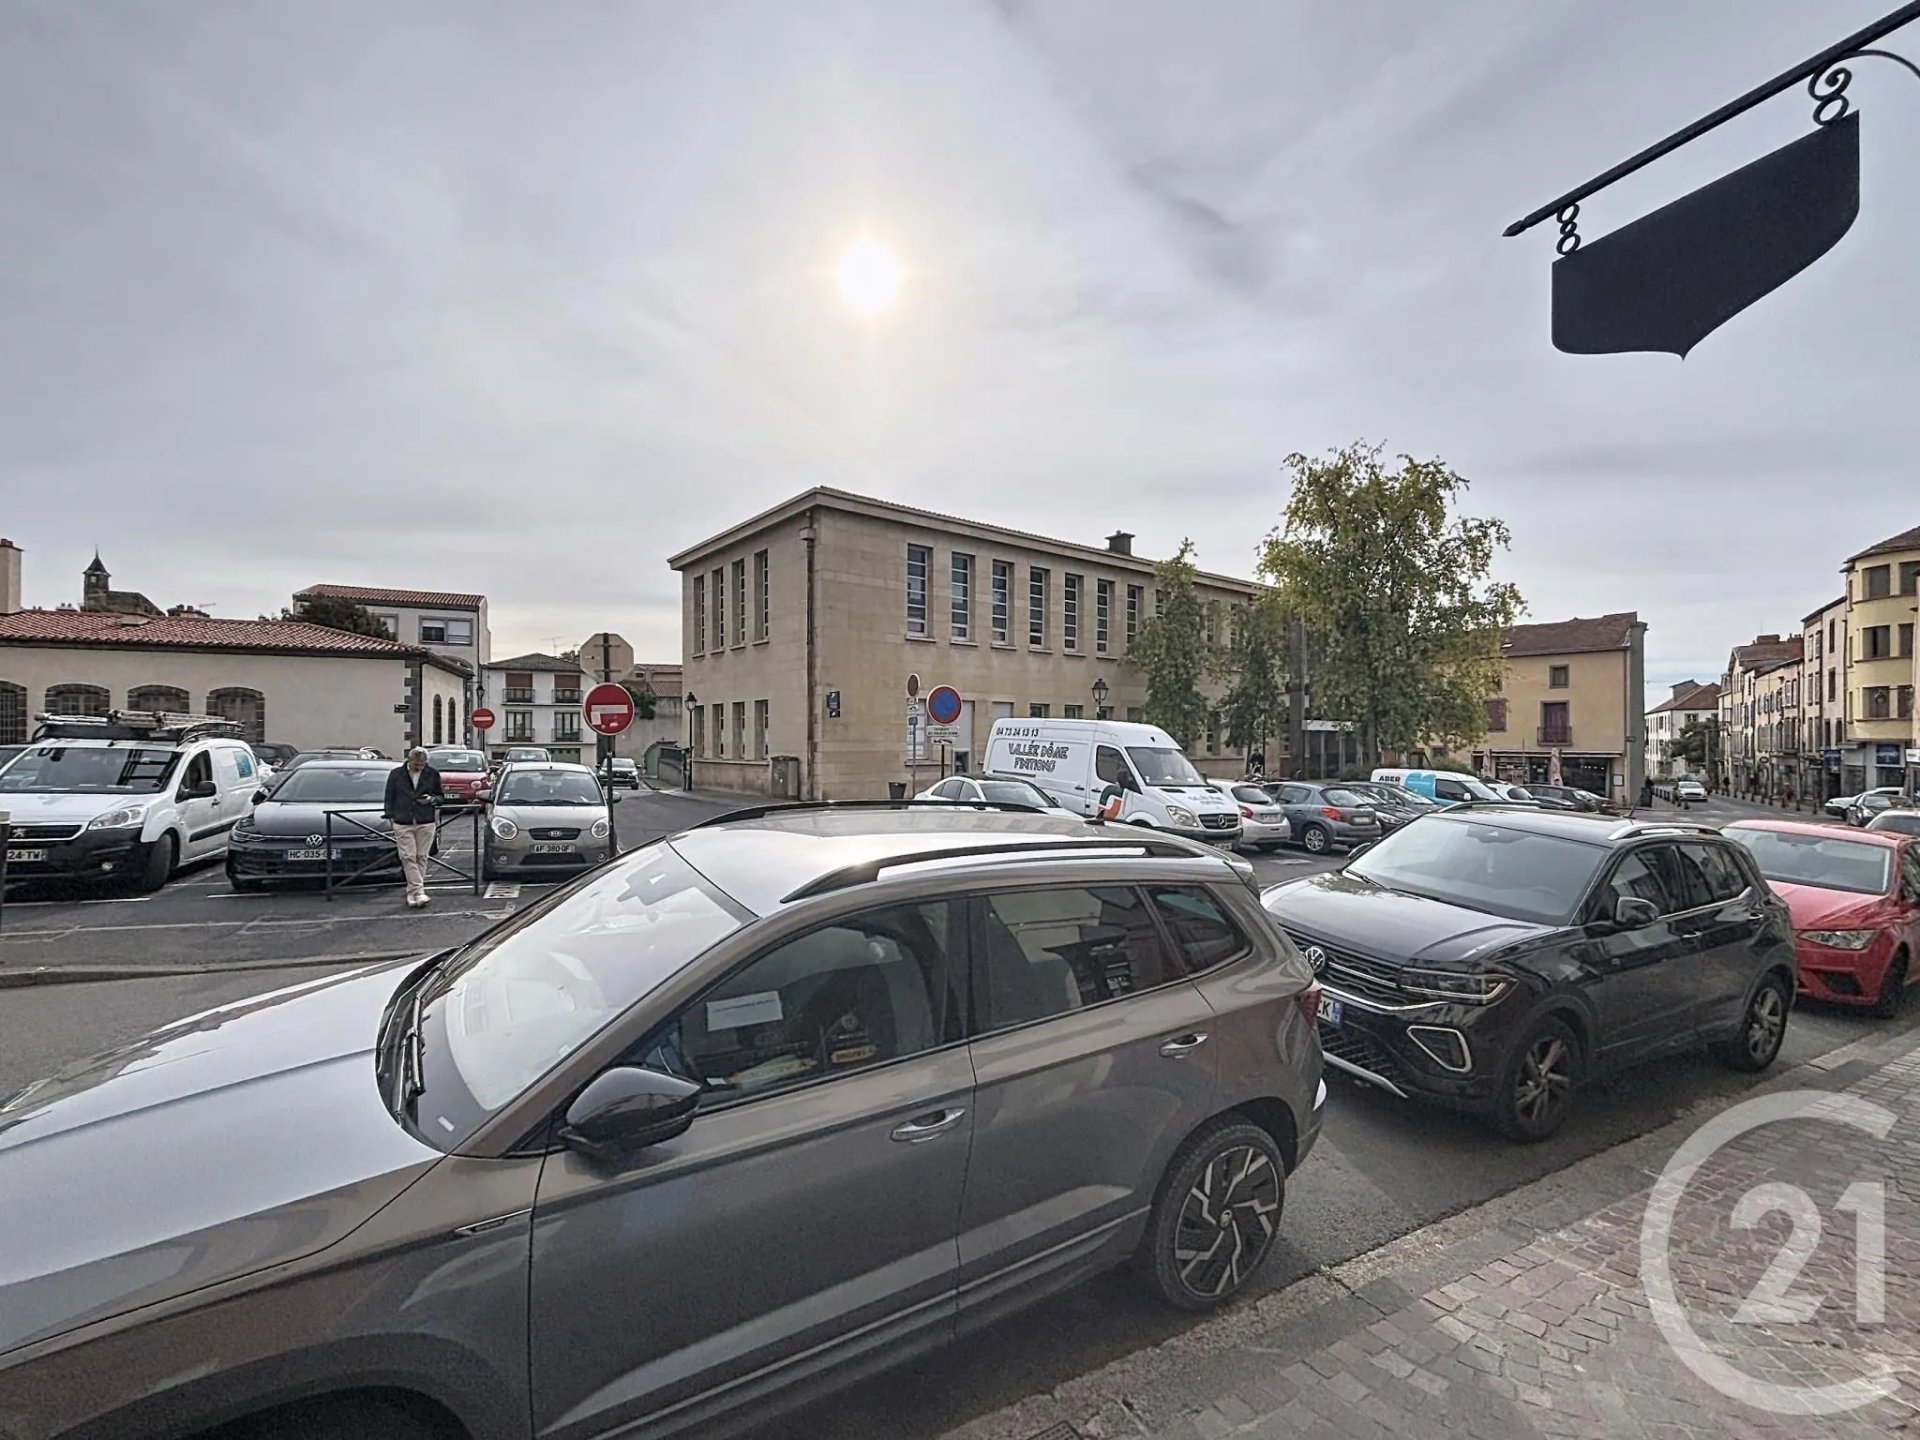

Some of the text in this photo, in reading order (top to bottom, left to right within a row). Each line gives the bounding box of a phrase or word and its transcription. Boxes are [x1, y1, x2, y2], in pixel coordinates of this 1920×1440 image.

[1004, 728, 1012, 736] 73
[1013, 728, 1021, 736] 24
[1022, 728, 1030, 737] 13
[1031, 728, 1039, 737] 13
